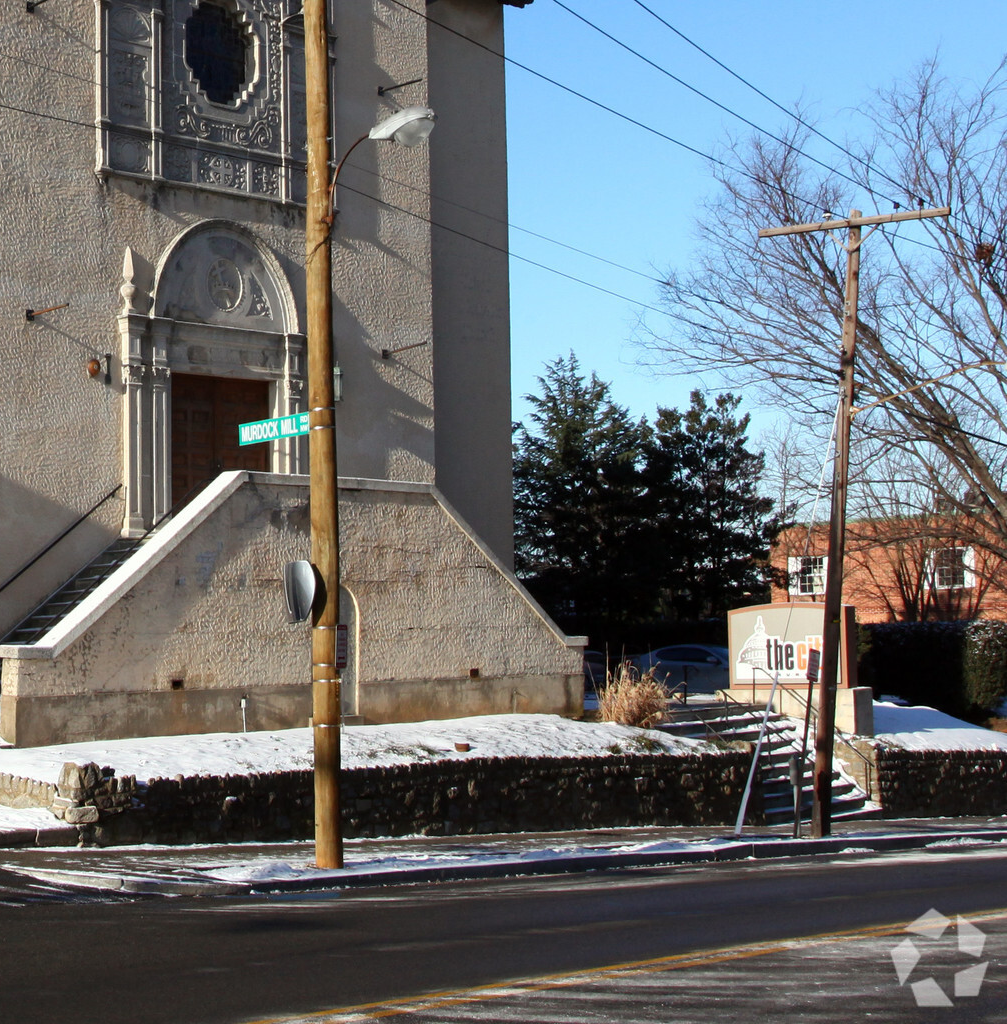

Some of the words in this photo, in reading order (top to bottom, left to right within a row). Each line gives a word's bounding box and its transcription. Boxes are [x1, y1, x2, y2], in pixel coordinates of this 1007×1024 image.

[241, 421, 279, 442] MURDOCK
[281, 418, 298, 435] MILL
[300, 415, 308, 423] RD
[300, 424, 308, 432] NW
